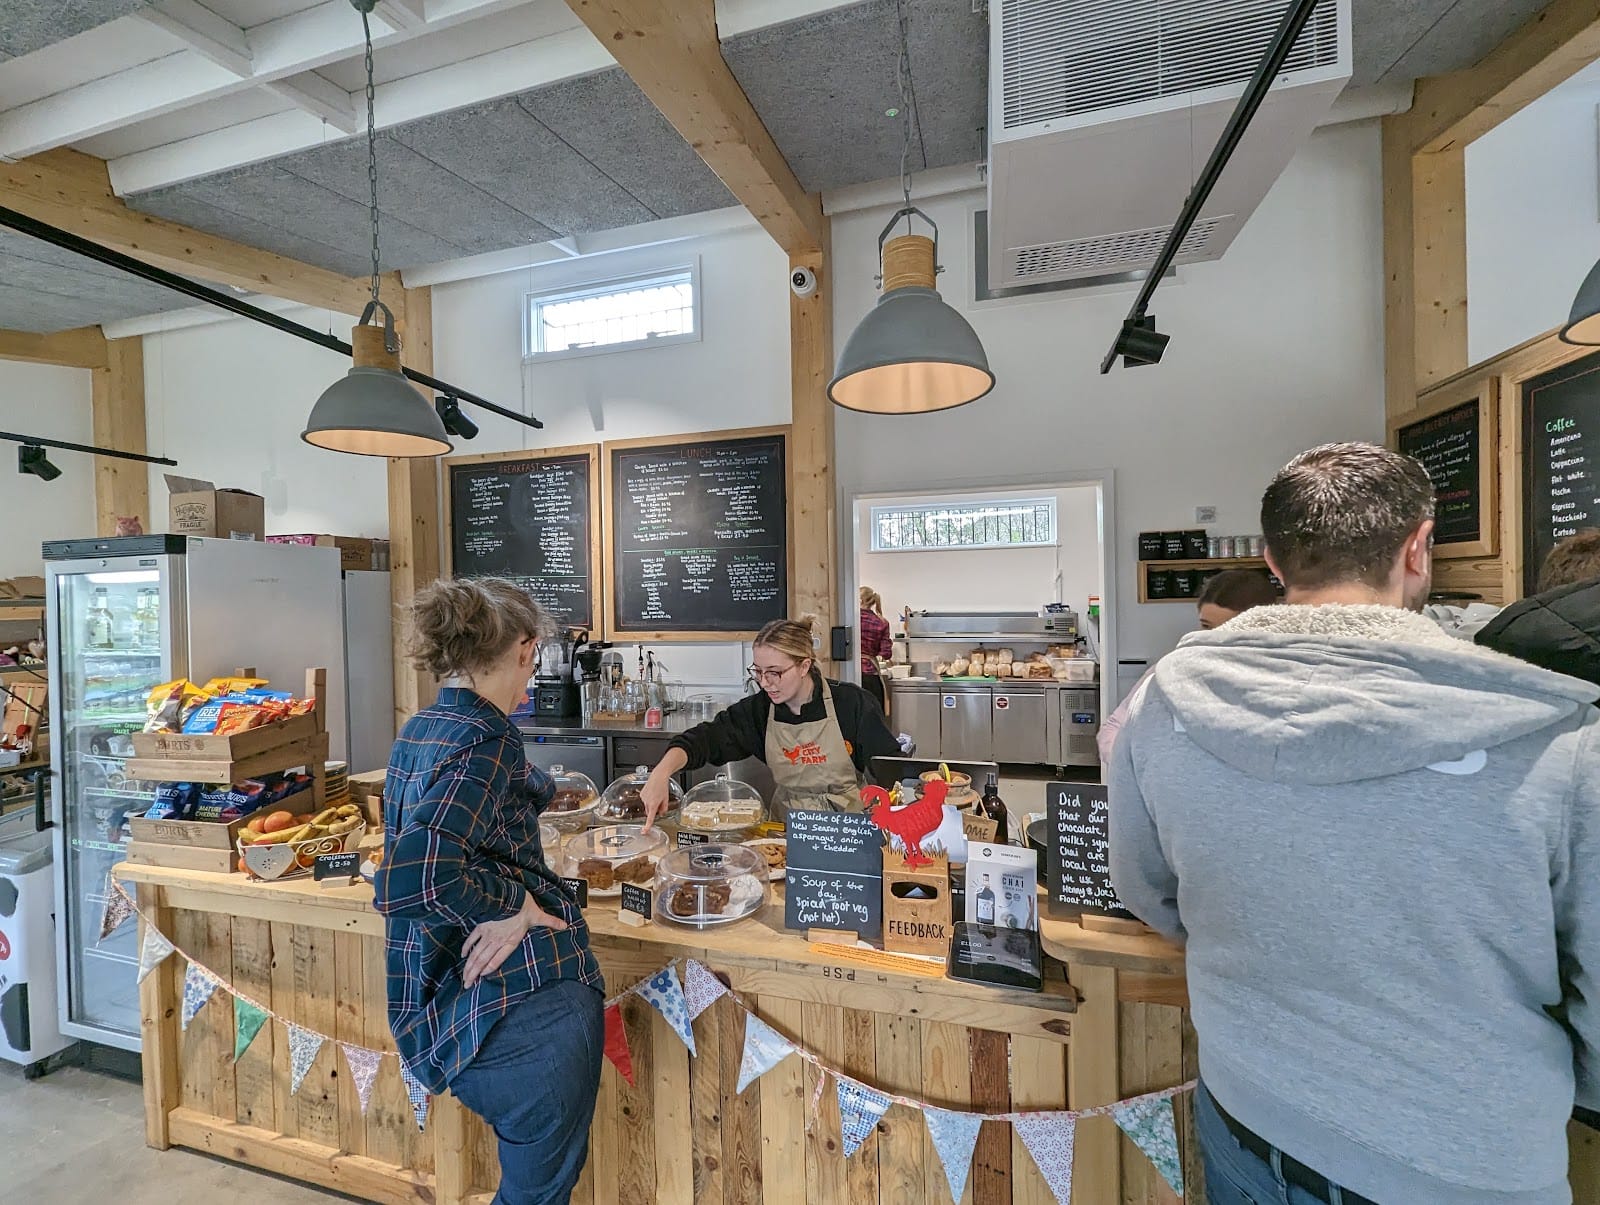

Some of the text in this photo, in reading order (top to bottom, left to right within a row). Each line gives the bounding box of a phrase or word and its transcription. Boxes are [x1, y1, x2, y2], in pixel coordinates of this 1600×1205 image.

[1545, 417, 1576, 433] Coffee
[1550, 432, 1582, 447] Americano
[680, 447, 712, 460] LUNCH
[1550, 447, 1567, 458] Latte
[1550, 455, 1585, 470] Cappuccino
[499, 465, 540, 477] BREAKFAST
[1551, 470, 1585, 485] Flat white
[1551, 486, 1572, 497] Mocha
[1551, 501, 1576, 513] Espresso
[1551, 511, 1588, 524] Macchiato
[179, 521, 202, 529] FRAGILE
[1552, 527, 1577, 538] Cortado
[202, 707, 222, 718] REA
[156, 737, 191, 751] BURTS
[802, 746, 821, 756] CITY
[801, 755, 827, 765] FARM
[1058, 792, 1082, 808] Did
[797, 811, 879, 831] Quiche of the day
[1058, 808, 1108, 824] that our
[155, 824, 189, 835] BURTS
[791, 821, 808, 832] New
[792, 833, 864, 846] asparagus, onion
[1059, 835, 1089, 848] milks,
[1059, 846, 1105, 862] Chai are
[1062, 859, 1088, 873] local
[801, 875, 864, 893] Soup of the
[1002, 877, 1024, 889] CHAI
[1061, 873, 1076, 884] We
[1079, 876, 1094, 885] use
[1059, 894, 1081, 906] Float
[795, 896, 869, 924] Spiced root veg
[798, 910, 846, 926] (not hot).
[889, 920, 946, 940] FEEDBACK
